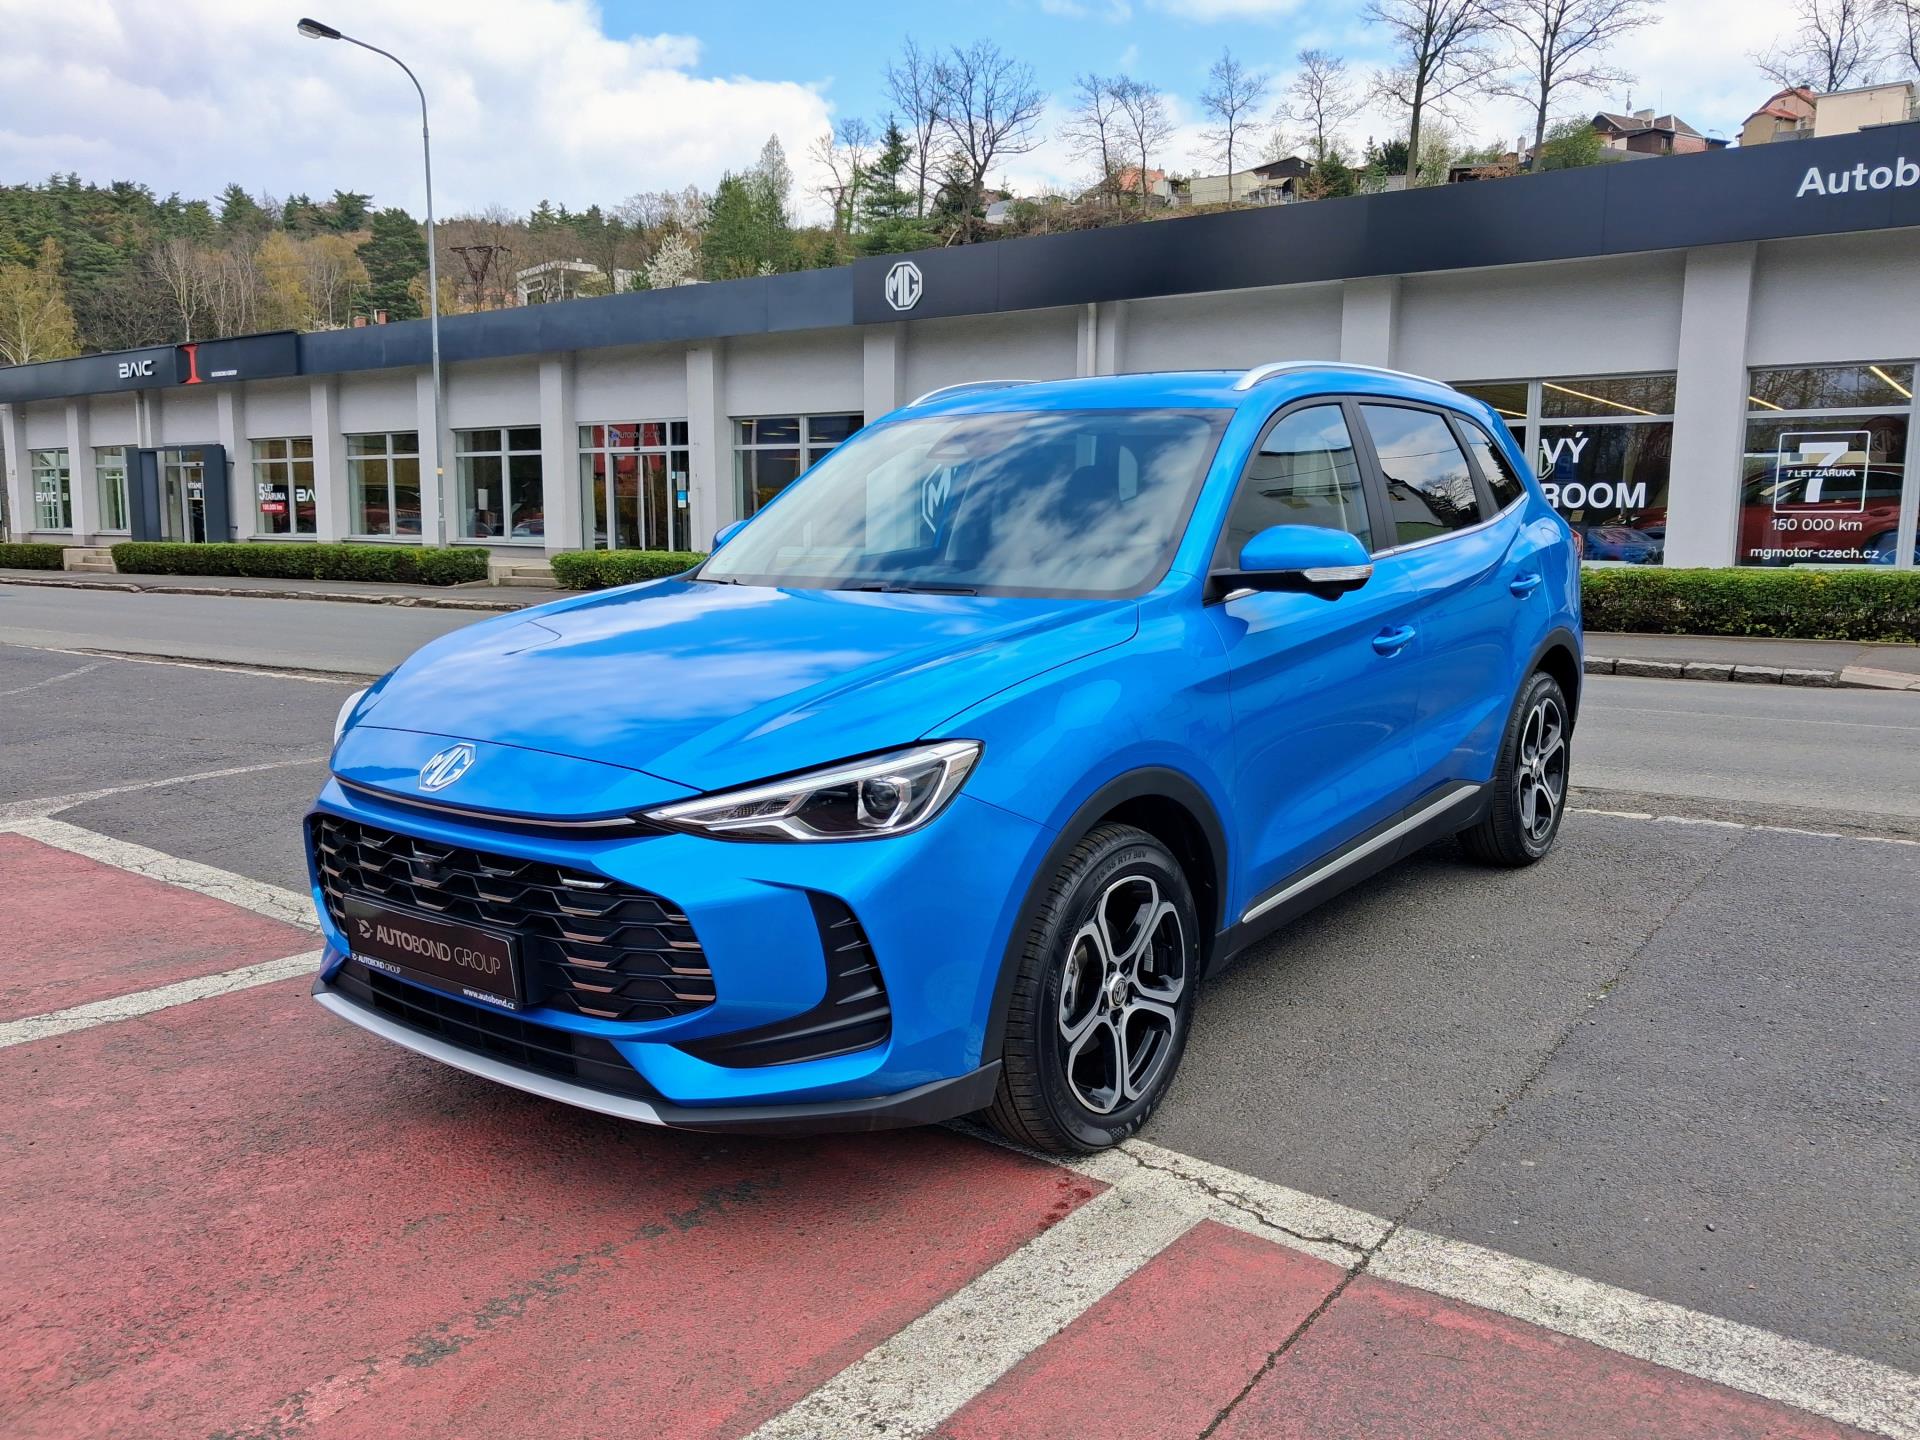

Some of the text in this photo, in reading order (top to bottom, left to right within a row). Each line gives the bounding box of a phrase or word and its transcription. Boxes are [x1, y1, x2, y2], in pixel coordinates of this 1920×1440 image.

[1796, 157, 1920, 198] Autob
[887, 263, 921, 308] MG
[119, 359, 153, 379] BAIC
[1541, 431, 1589, 464] VÝ
[1786, 467, 1857, 478] 7 LET ZÁRUKA
[1799, 441, 1849, 503] 7
[1771, 518, 1863, 531] 150 000 km
[1750, 547, 1880, 560] mgmotor-czech.cz
[421, 745, 473, 788] MG
[376, 924, 501, 975] AUTOBOND GROUP
